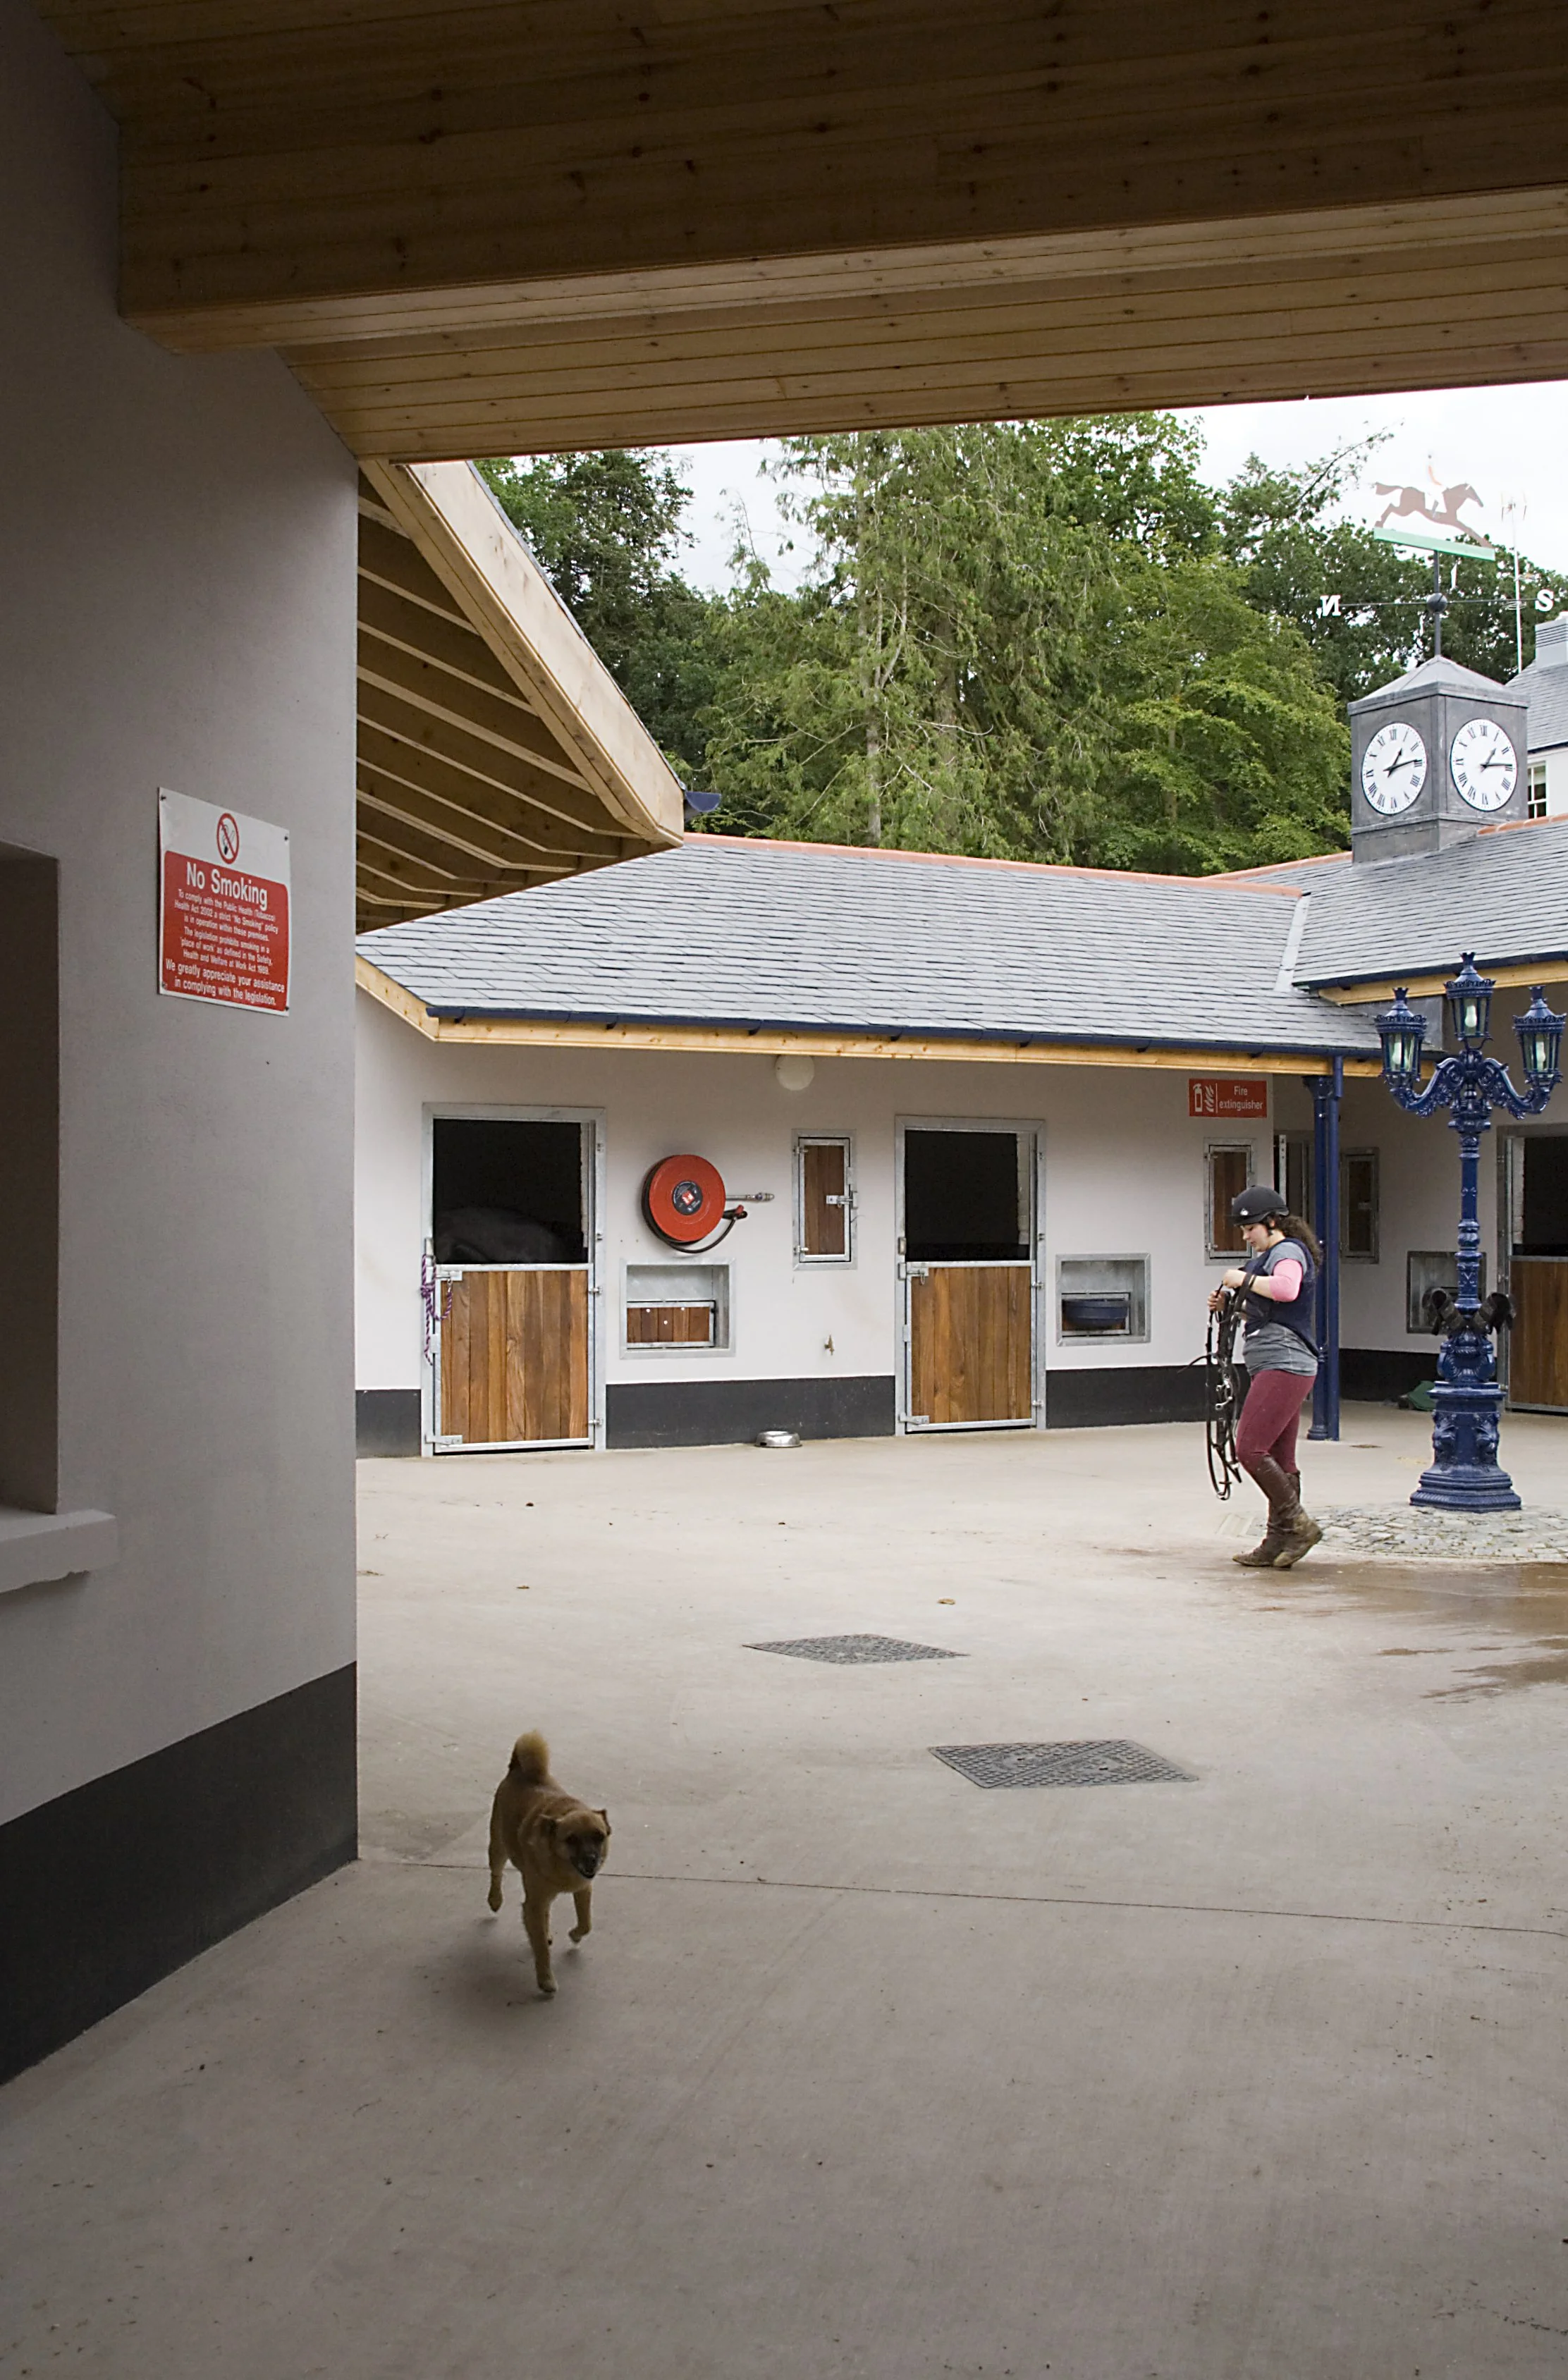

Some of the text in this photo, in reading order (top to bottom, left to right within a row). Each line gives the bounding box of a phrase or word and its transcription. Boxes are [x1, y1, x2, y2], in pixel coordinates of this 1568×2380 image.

[1535, 589, 1554, 611] S
[187, 862, 267, 911] No Smoking
[178, 889, 184, 897] To
[186, 892, 202, 904] comply
[224, 902, 237, 912] Public
[239, 905, 253, 916] Health
[176, 900, 190, 911] Health
[201, 907, 213, 916] 2002
[220, 912, 231, 921] strict
[265, 924, 278, 934] policy
[197, 917, 218, 929] operation
[220, 924, 232, 933] within
[234, 926, 247, 936] these
[185, 926, 193, 936] The
[195, 930, 218, 942] legislation
[220, 936, 239, 947] prohibits
[241, 942, 259, 953] smoking
[184, 950, 199, 959] Health
[201, 954, 209, 962] and
[211, 955, 228, 966] Welfare
[236, 961, 247, 970] Work
[225, 948, 241, 957] defined
[257, 955, 272, 966] Safety,
[166, 959, 284, 993] We greatly appreciate your assistance
[176, 976, 276, 1005] in complying with the legislation.
[1234, 1085, 1248, 1096] Fire
[1219, 1099, 1263, 1111] extinguisher
